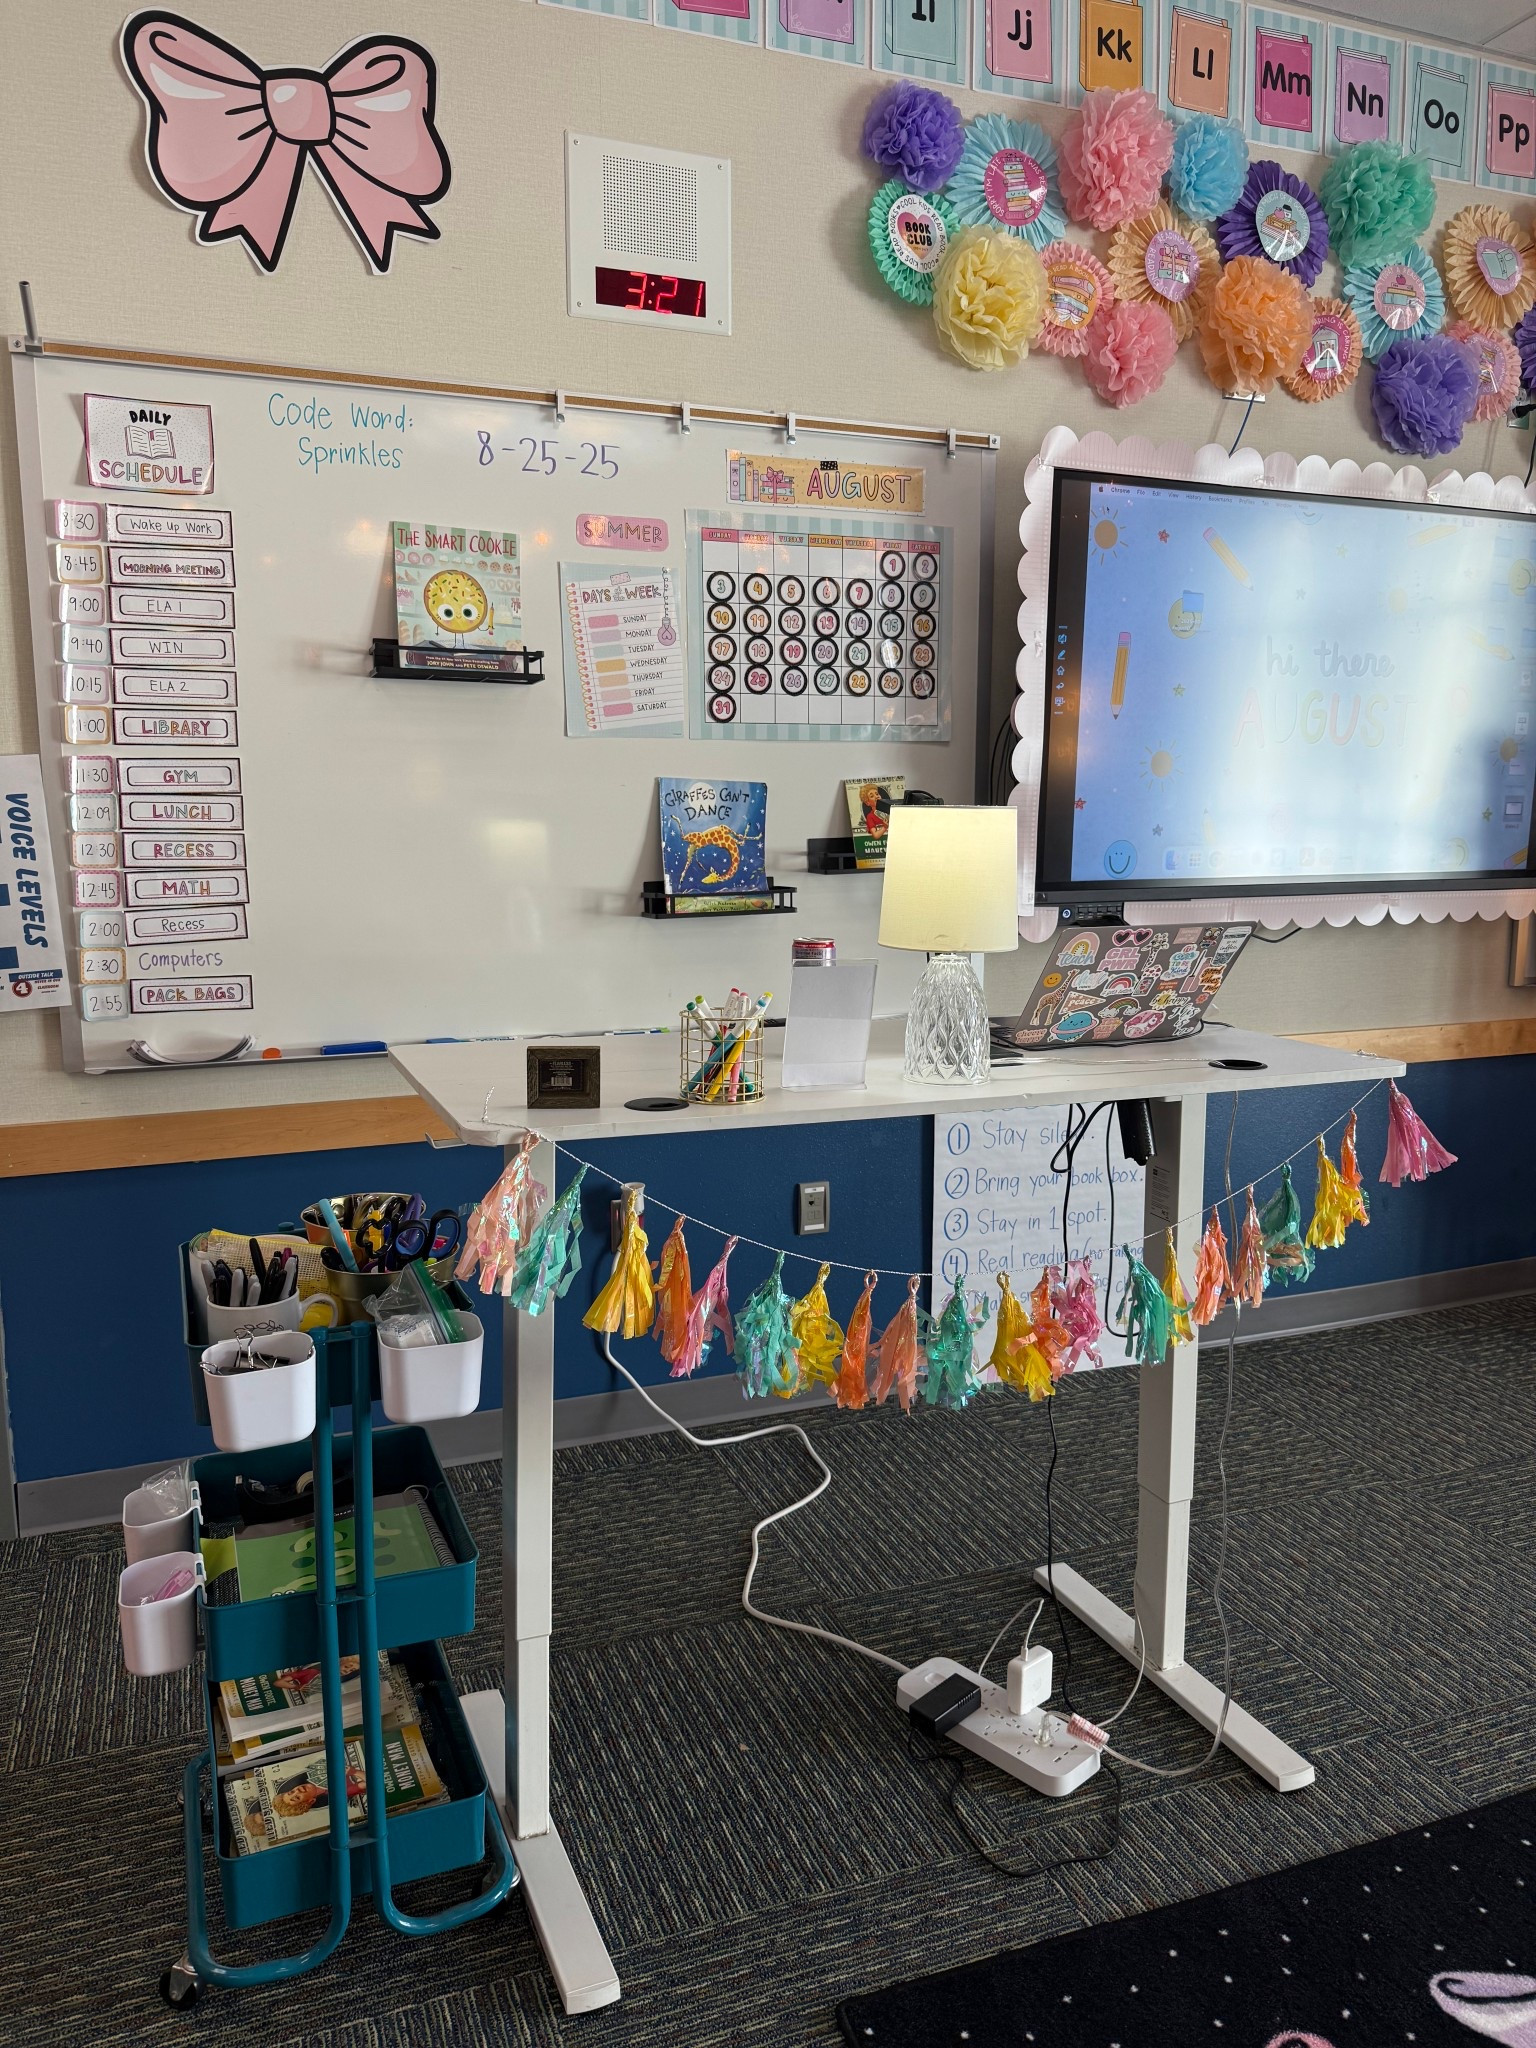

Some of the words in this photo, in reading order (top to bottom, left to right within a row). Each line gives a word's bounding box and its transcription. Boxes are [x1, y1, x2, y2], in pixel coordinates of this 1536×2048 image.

[1007, 9, 1033, 51] Jj
[1097, 26, 1132, 64] Kk
[1192, 47, 1214, 81] Ll
[1262, 60, 1312, 98] Mm
[1347, 84, 1384, 118] Nn
[1424, 100, 1460, 134] Oo
[1498, 113, 1531, 153] Pp
[905, 221, 931, 235] BOOK
[906, 233, 933, 247] CLUB
[624, 271, 704, 317] 3:21
[129, 409, 172, 427] DAILY
[267, 392, 333, 430] Code
[350, 401, 414, 432] Word:
[298, 436, 404, 474] Sprinkles
[476, 429, 622, 480] 8-25-25
[98, 459, 204, 486] SCHEDULE
[806, 466, 912, 505] AUGUST
[1110, 486, 1131, 495] Chrome
[1185, 493, 1202, 502] History
[62, 511, 95, 531] 8:30
[129, 518, 162, 532] Wake
[166, 520, 180, 534] Up
[185, 522, 213, 534] Work
[583, 520, 663, 544] SUMMER
[397, 527, 421, 546] THE
[424, 529, 466, 551] SMART
[469, 535, 517, 557] COOKIE
[64, 555, 98, 573] 8:45
[123, 562, 172, 574] MORNING
[175, 564, 221, 576] MEETING
[889, 558, 897, 572] 1
[921, 559, 929, 573] 2
[582, 588, 612, 604] DAYS
[624, 584, 662, 600] WEEK
[717, 578, 726, 594] 3
[753, 580, 763, 595] 4
[787, 583, 796, 599] 5
[822, 584, 831, 599] 6
[855, 586, 864, 600] 7
[887, 588, 896, 602] 8
[919, 589, 927, 603] 9
[69, 596, 100, 612] 9:00
[147, 599, 172, 612] ELA
[622, 614, 648, 624] SUNDAY
[713, 610, 730, 625] 10
[750, 613, 766, 628] 11
[784, 615, 800, 630] 12
[819, 615, 834, 630] 13
[851, 616, 866, 631] 14
[884, 618, 899, 632] 15
[916, 618, 931, 632] 16
[625, 629, 652, 638] MONDAY
[70, 636, 103, 654] 9:40
[149, 641, 184, 654] WIN
[628, 644, 655, 653] TUESDAY
[714, 641, 731, 656] 17
[751, 643, 767, 658] 18
[786, 644, 801, 659] 19
[817, 644, 834, 659] 20
[851, 646, 866, 660] 21
[630, 656, 668, 668] WEDNESDAY
[915, 650, 930, 664] 23
[1266, 635, 1300, 677] hi
[1313, 640, 1396, 678] there
[70, 675, 102, 694] 10:15
[632, 671, 664, 682] THURSDAY
[713, 669, 731, 686] 24
[750, 670, 767, 687] 25
[786, 673, 802, 689] 26
[819, 672, 835, 687] 27
[851, 674, 866, 688] 28
[883, 674, 899, 689] 29
[915, 676, 931, 691] 30
[149, 679, 175, 692] ELA
[179, 681, 190, 692] 2
[634, 687, 656, 697] FRIDAY
[637, 702, 668, 712] SATURDAY
[715, 699, 731, 715] 31
[1232, 688, 1419, 749] AUGUST
[141, 719, 211, 736] LIBRARY
[75, 767, 110, 784] 11:30
[162, 770, 199, 784] GYM
[664, 787, 716, 807] GIRAFFES
[719, 787, 750, 803] CAN'T
[76, 804, 112, 822] 12:09
[152, 803, 212, 821] LUNCH
[684, 804, 733, 821] DANCE
[5, 793, 37, 862] VOICE
[80, 841, 116, 858] 12:30
[153, 842, 215, 858] RECESS
[81, 881, 117, 900] 12:45
[162, 880, 212, 896] MATH
[16, 868, 49, 949] LEVELS
[88, 921, 121, 938] 2:00
[160, 917, 206, 933] Recess
[138, 949, 224, 972] Computers
[1059, 950, 1095, 967] teach
[1105, 947, 1140, 960] GRL
[85, 957, 120, 974] 2:30
[1100, 958, 1139, 971] PWR
[18, 972, 40, 980] OUTSIDE
[40, 971, 54, 979] TALK
[15, 982, 29, 994] 4
[145, 986, 188, 1004] PACK
[194, 985, 236, 1001] BAGS
[91, 993, 124, 1012] 2:55
[1069, 998, 1096, 1006] peace
[982, 1119, 1028, 1152] Stay
[975, 1168, 1020, 1197] Bring
[1029, 1171, 1063, 1196] your
[1070, 1166, 1103, 1186] book
[977, 1208, 1018, 1237] Stay
[1028, 1213, 1041, 1231] in
[1067, 1201, 1107, 1235] spot.
[978, 1245, 1015, 1273] Real
[239, 1676, 260, 1699] MONEY
[245, 1697, 265, 1711] MAN
[385, 1741, 406, 1761] MAN
[392, 1761, 416, 1791] MONEY
